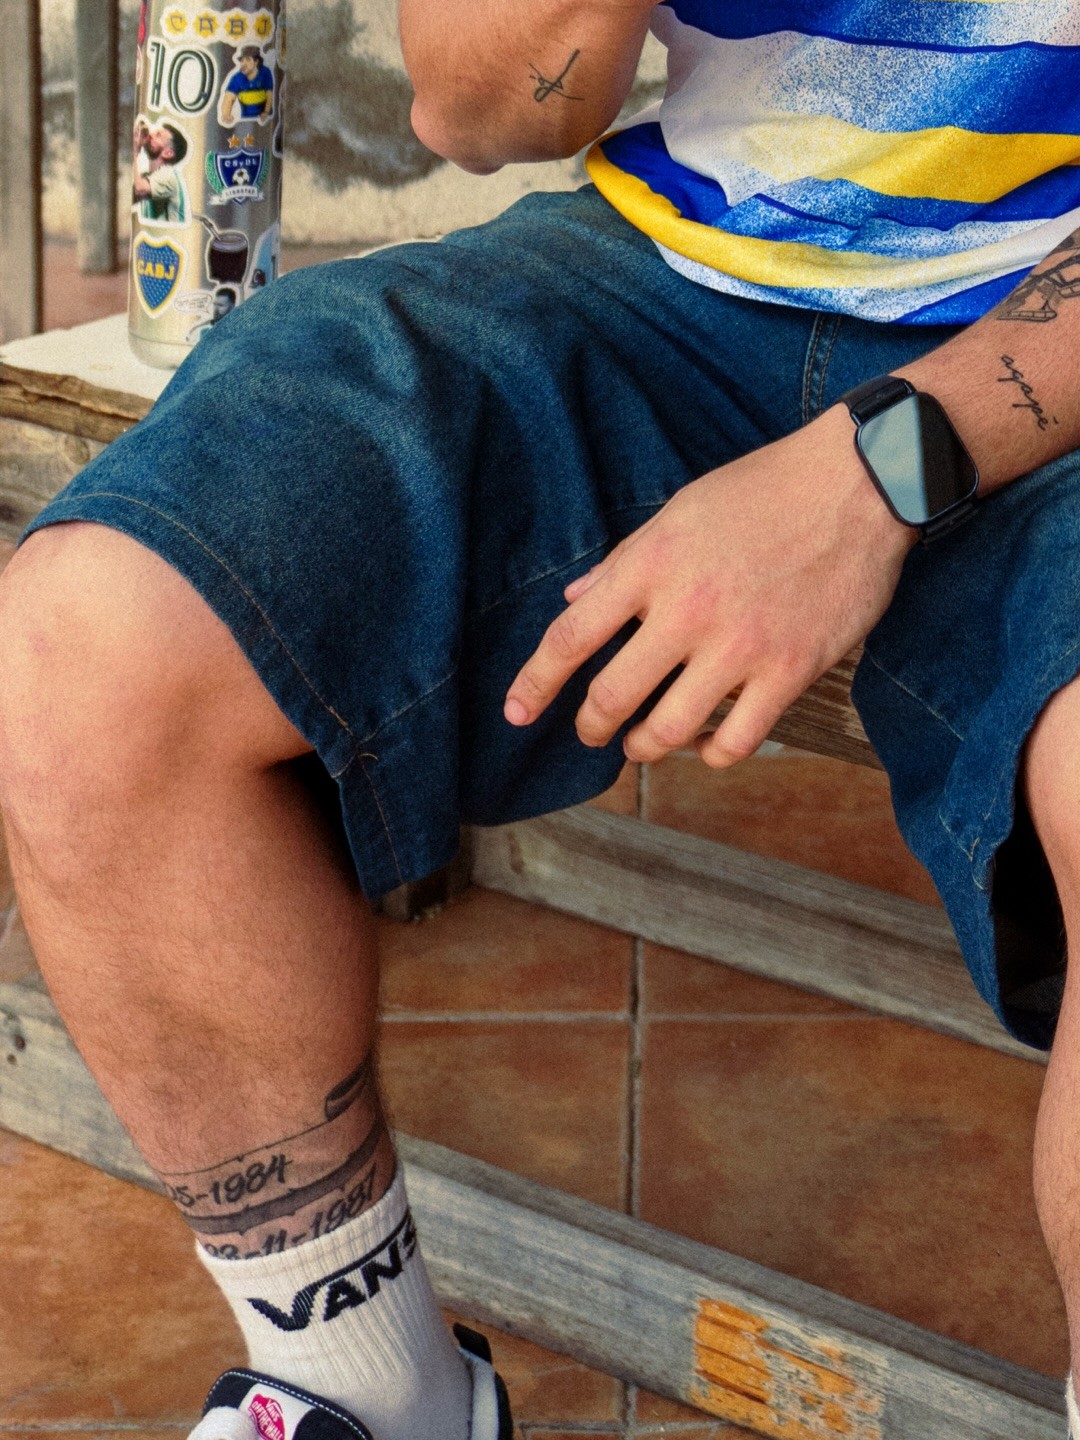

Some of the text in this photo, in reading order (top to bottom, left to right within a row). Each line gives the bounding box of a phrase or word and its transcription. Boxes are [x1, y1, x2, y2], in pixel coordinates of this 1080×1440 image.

[170, 15, 268, 35] CABJ
[150, 42, 215, 114] 10
[137, 259, 175, 281] CABJ
[265, 1398, 281, 1421] VANS
